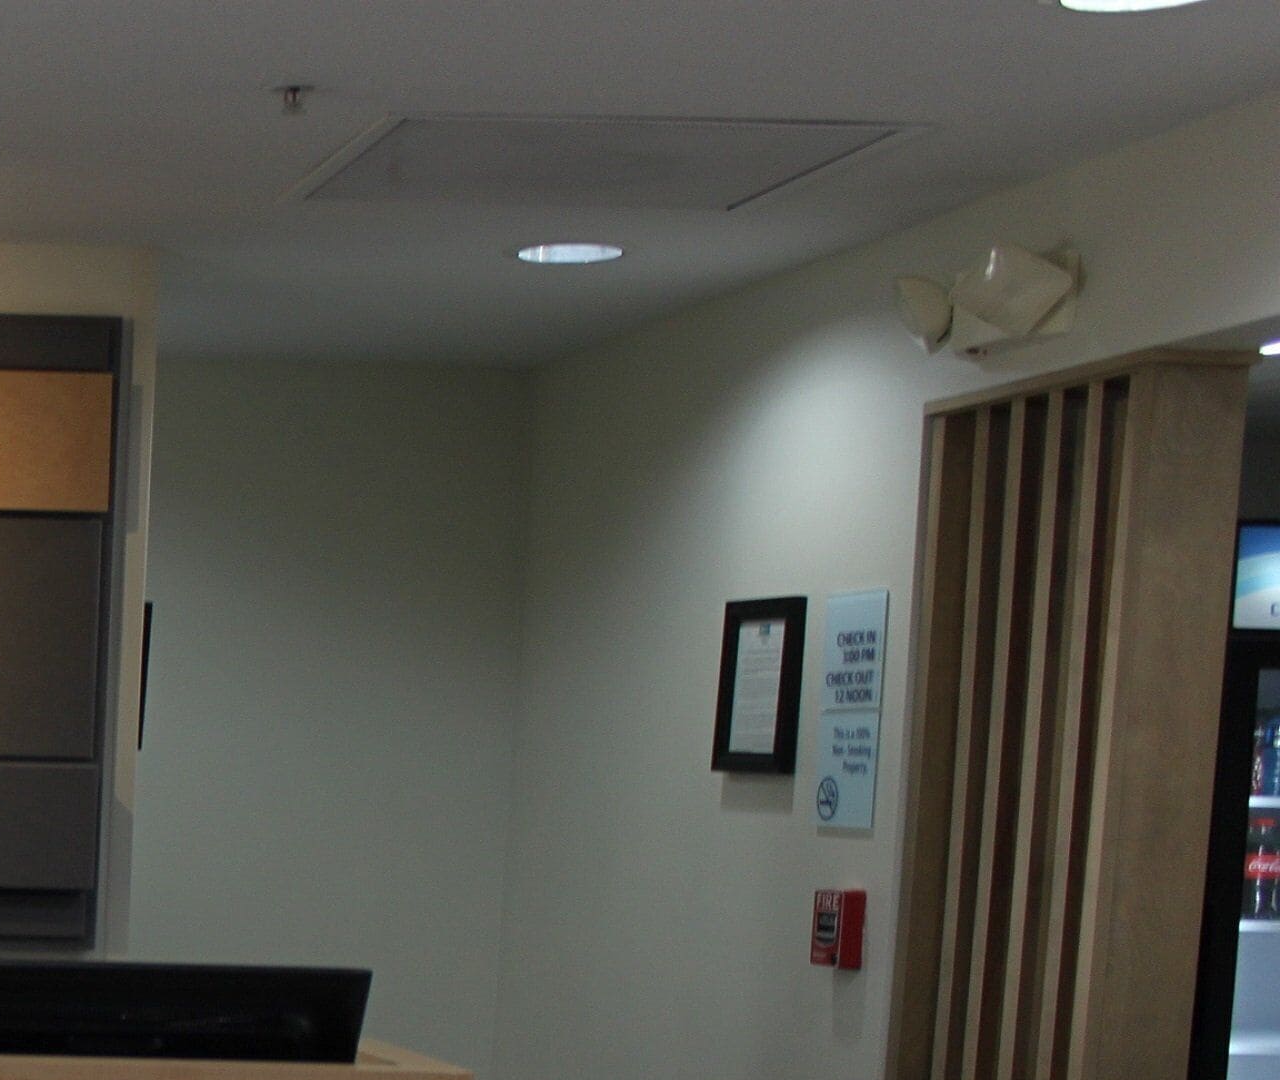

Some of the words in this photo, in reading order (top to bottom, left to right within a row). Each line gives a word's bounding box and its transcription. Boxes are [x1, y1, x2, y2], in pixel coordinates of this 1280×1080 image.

[836, 631, 865, 647] CHECK
[825, 671, 854, 688] CHECK
[846, 688, 872, 703] NOON
[816, 893, 840, 912] FIRE
